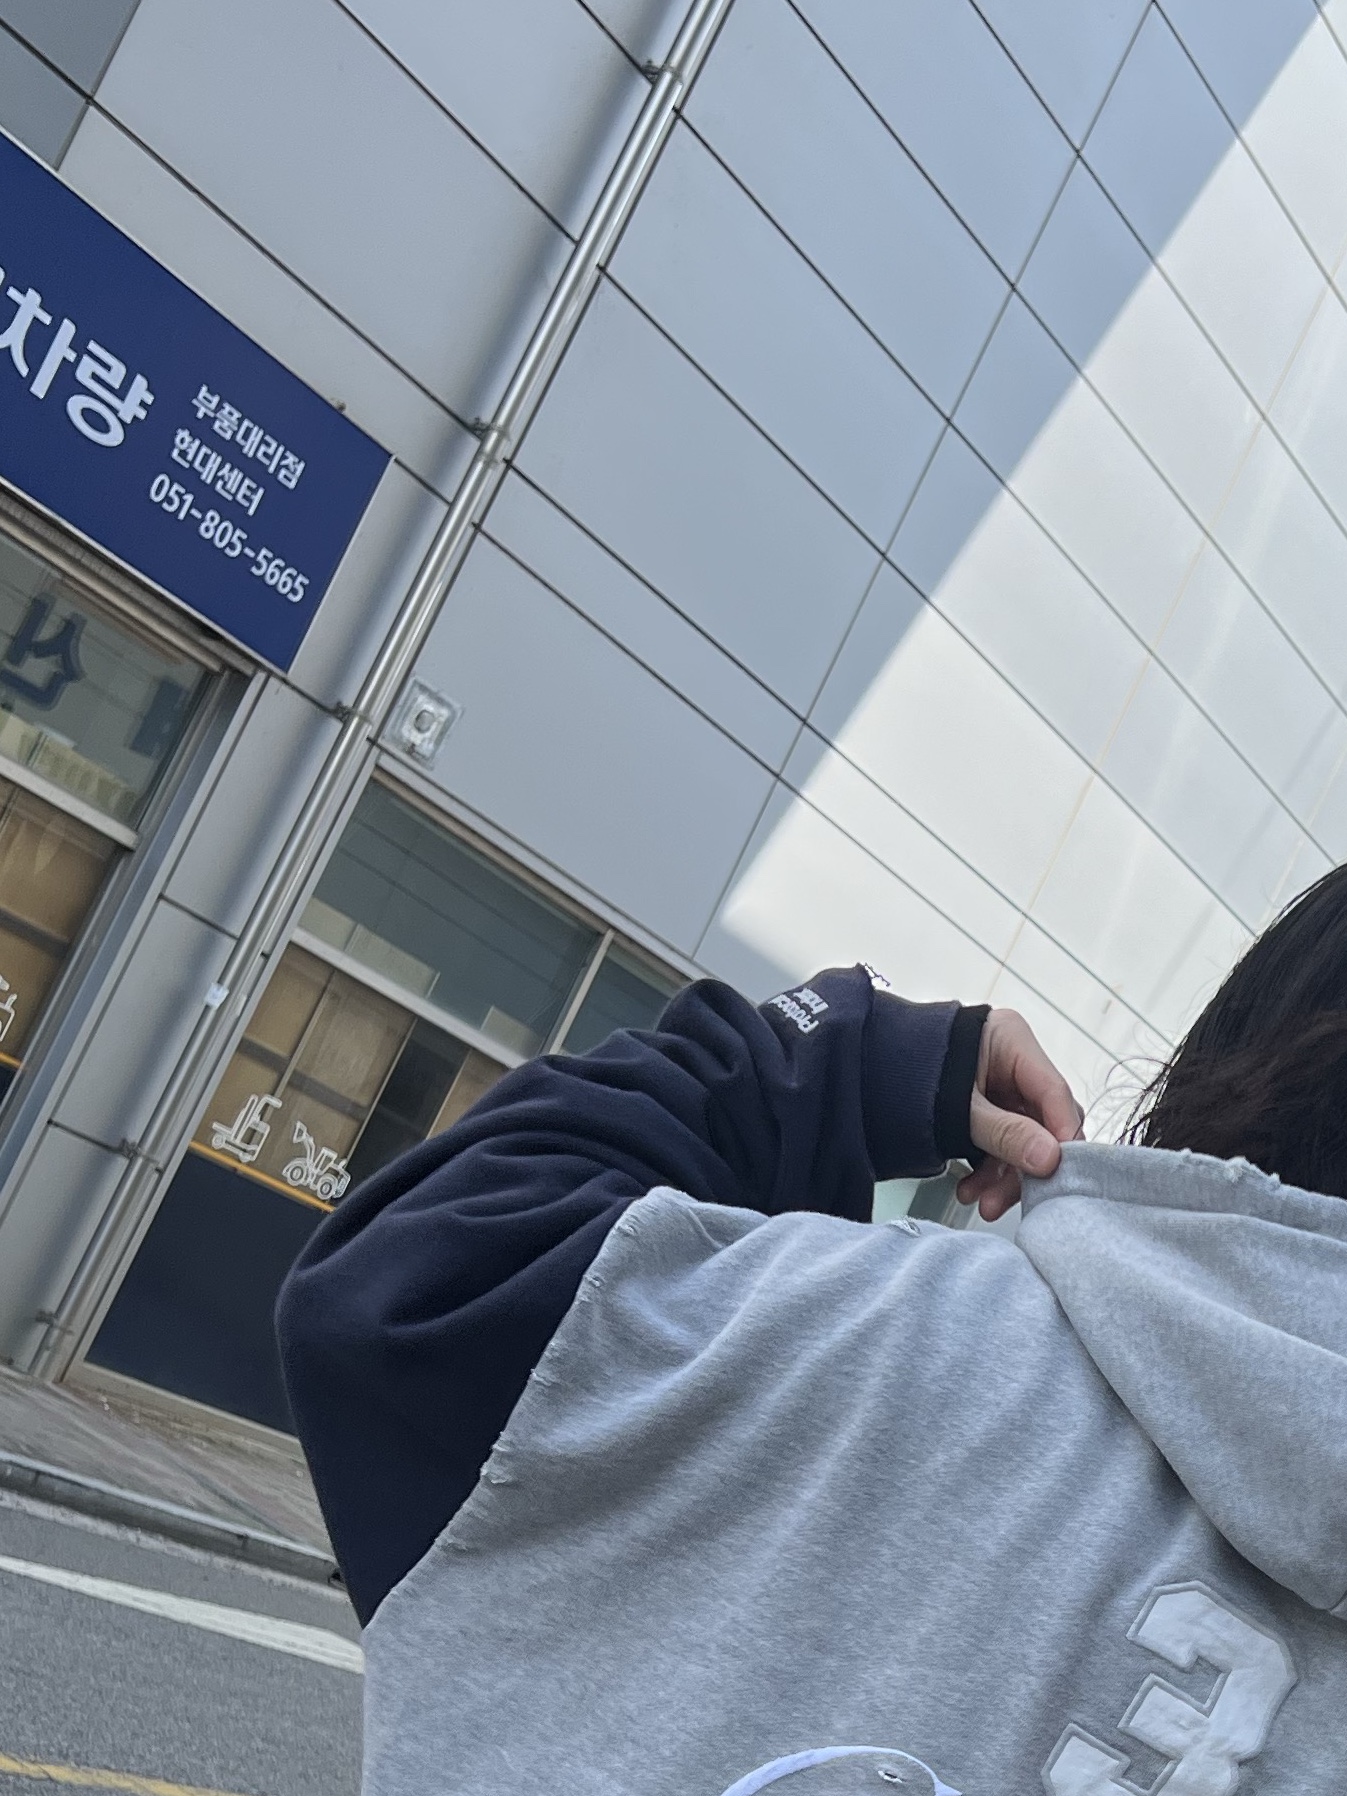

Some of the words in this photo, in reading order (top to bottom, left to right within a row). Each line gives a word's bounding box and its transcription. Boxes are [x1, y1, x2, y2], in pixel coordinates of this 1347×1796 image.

[0, 266, 154, 447] 차량
[171, 428, 265, 516] 현대센터
[191, 384, 305, 490] 부품대리점
[150, 474, 310, 603] 051-805-5665
